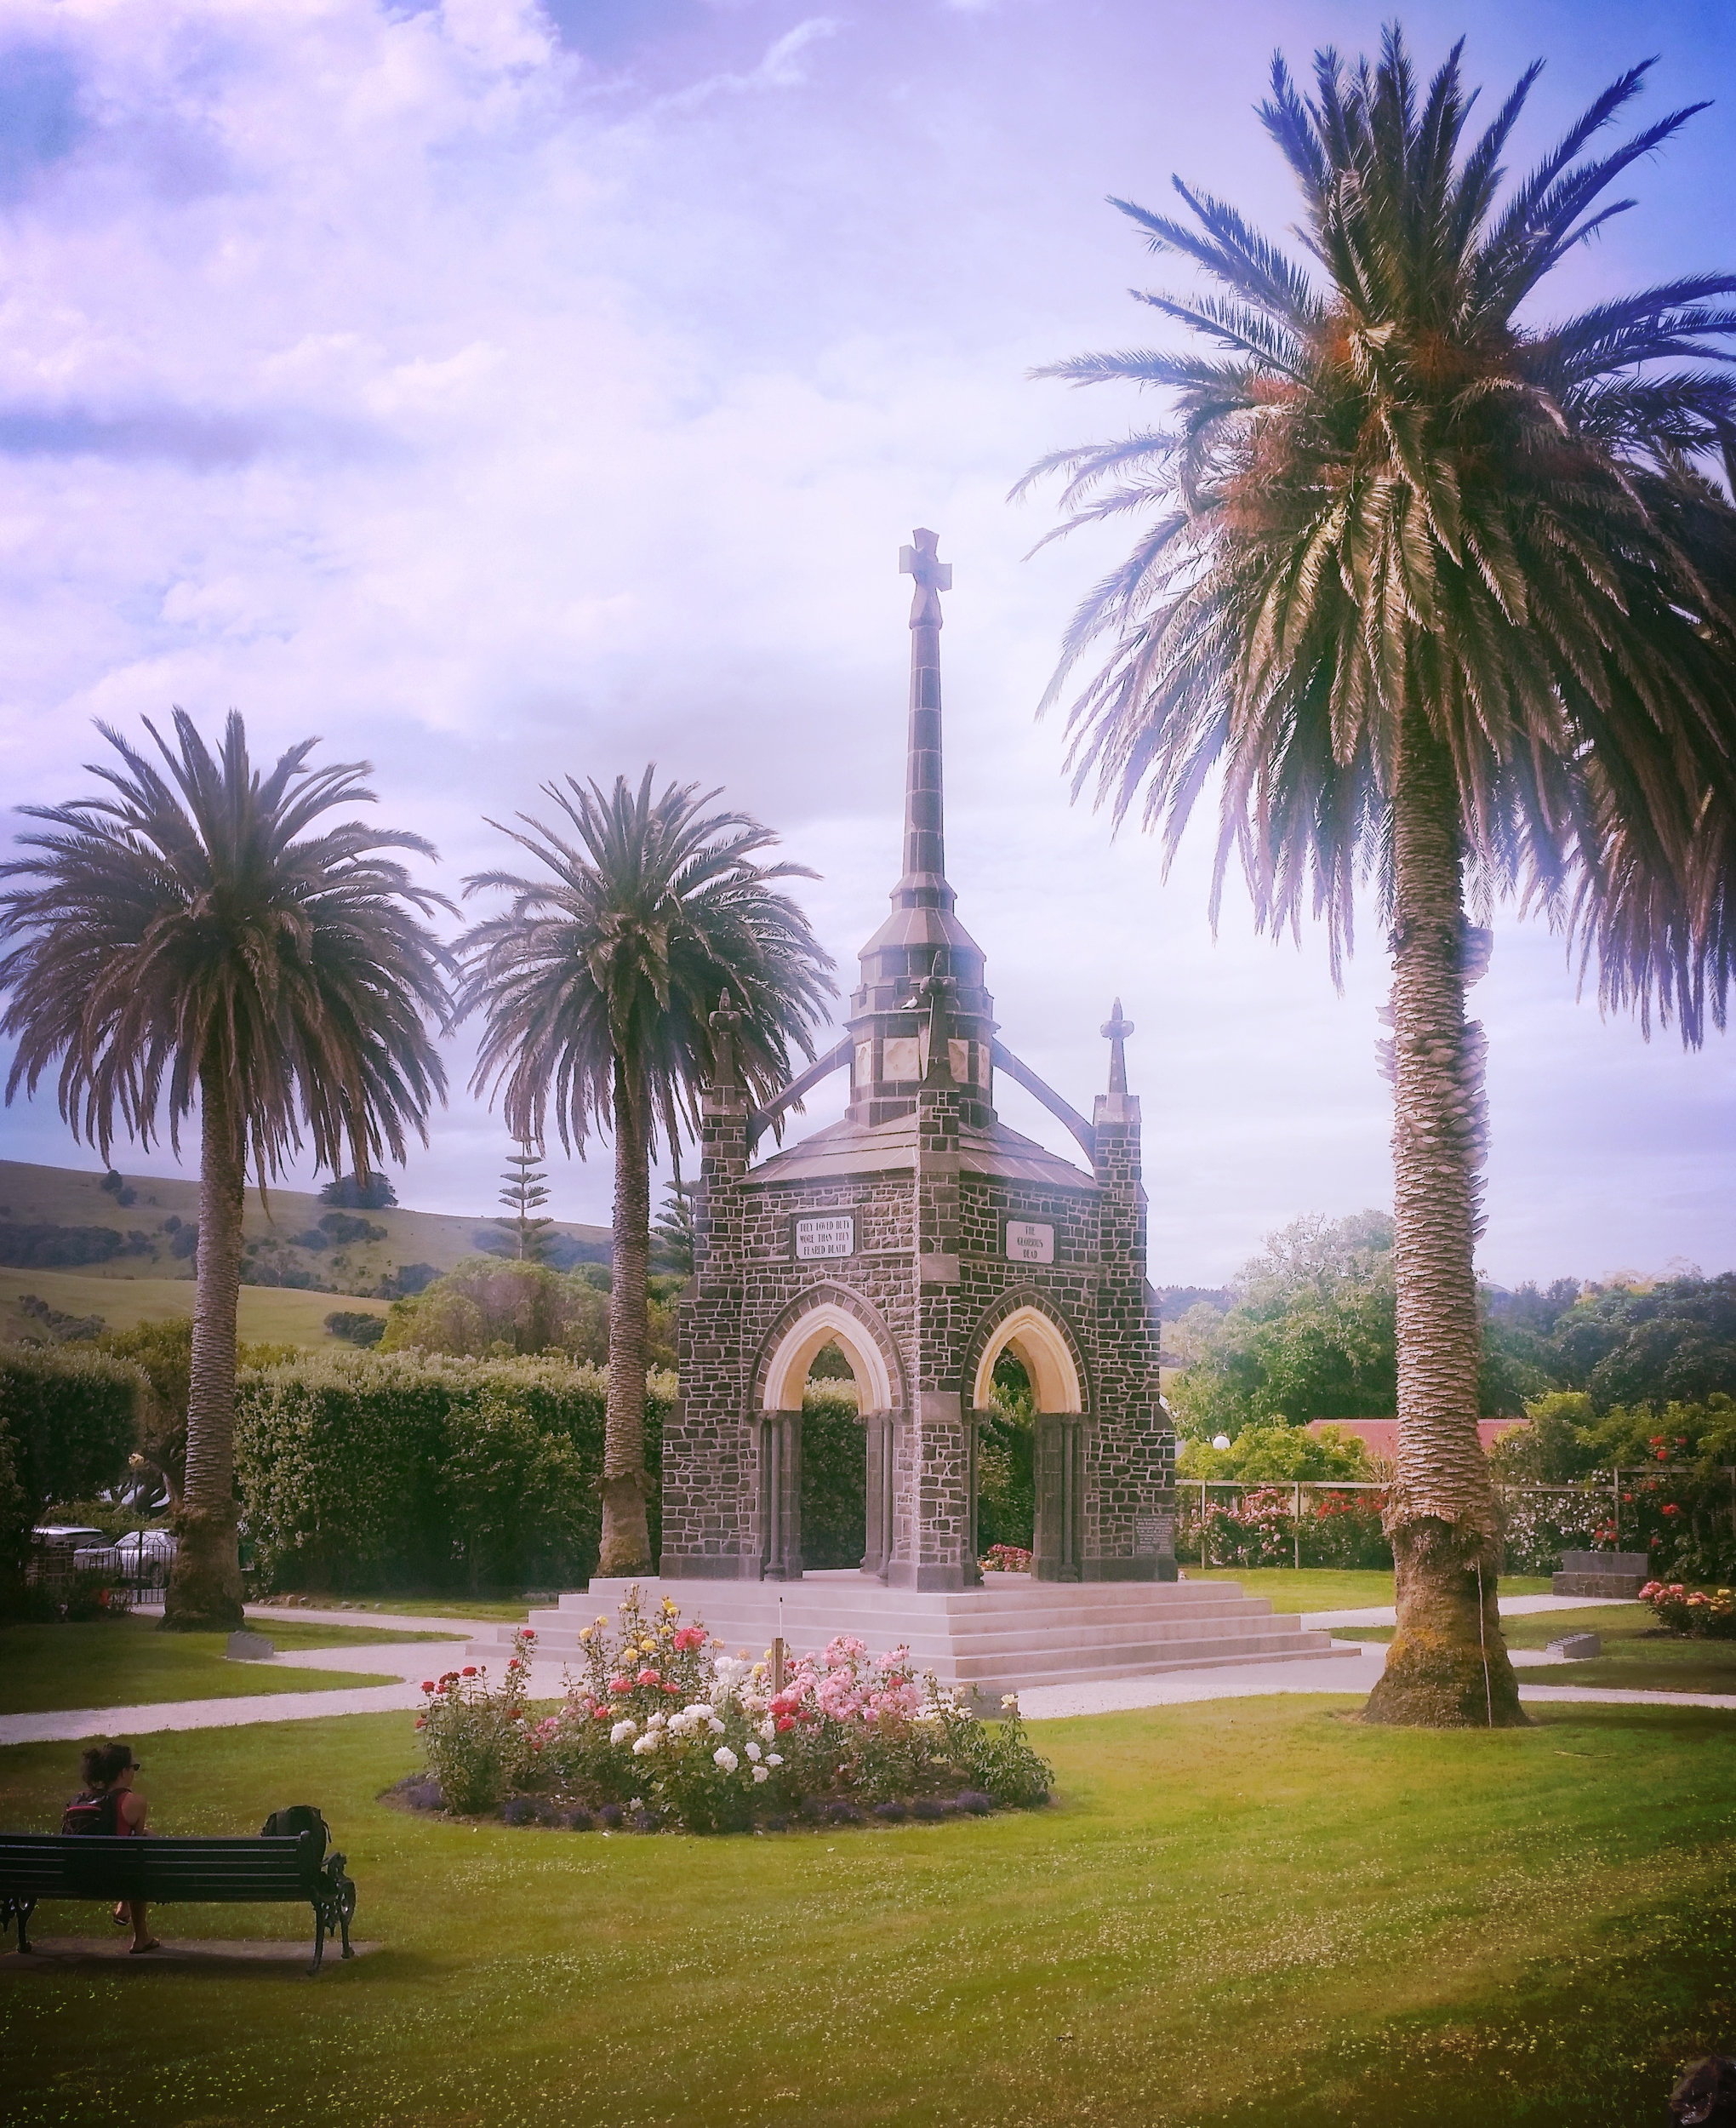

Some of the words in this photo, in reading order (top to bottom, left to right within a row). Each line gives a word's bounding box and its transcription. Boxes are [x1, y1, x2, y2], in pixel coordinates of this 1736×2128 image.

[800, 1222, 813, 1233] THEY
[815, 1221, 834, 1231] LOVED
[836, 1220, 849, 1230] DUTY
[1025, 1226, 1036, 1235] THE
[799, 1234, 814, 1244] MORE
[818, 1233, 832, 1243] THAN
[836, 1232, 849, 1242] THEY
[1017, 1237, 1043, 1248] GLORIOUS
[803, 1244, 825, 1256] FEARED
[827, 1244, 846, 1254] DEATH
[1023, 1249, 1038, 1259] DEAD
